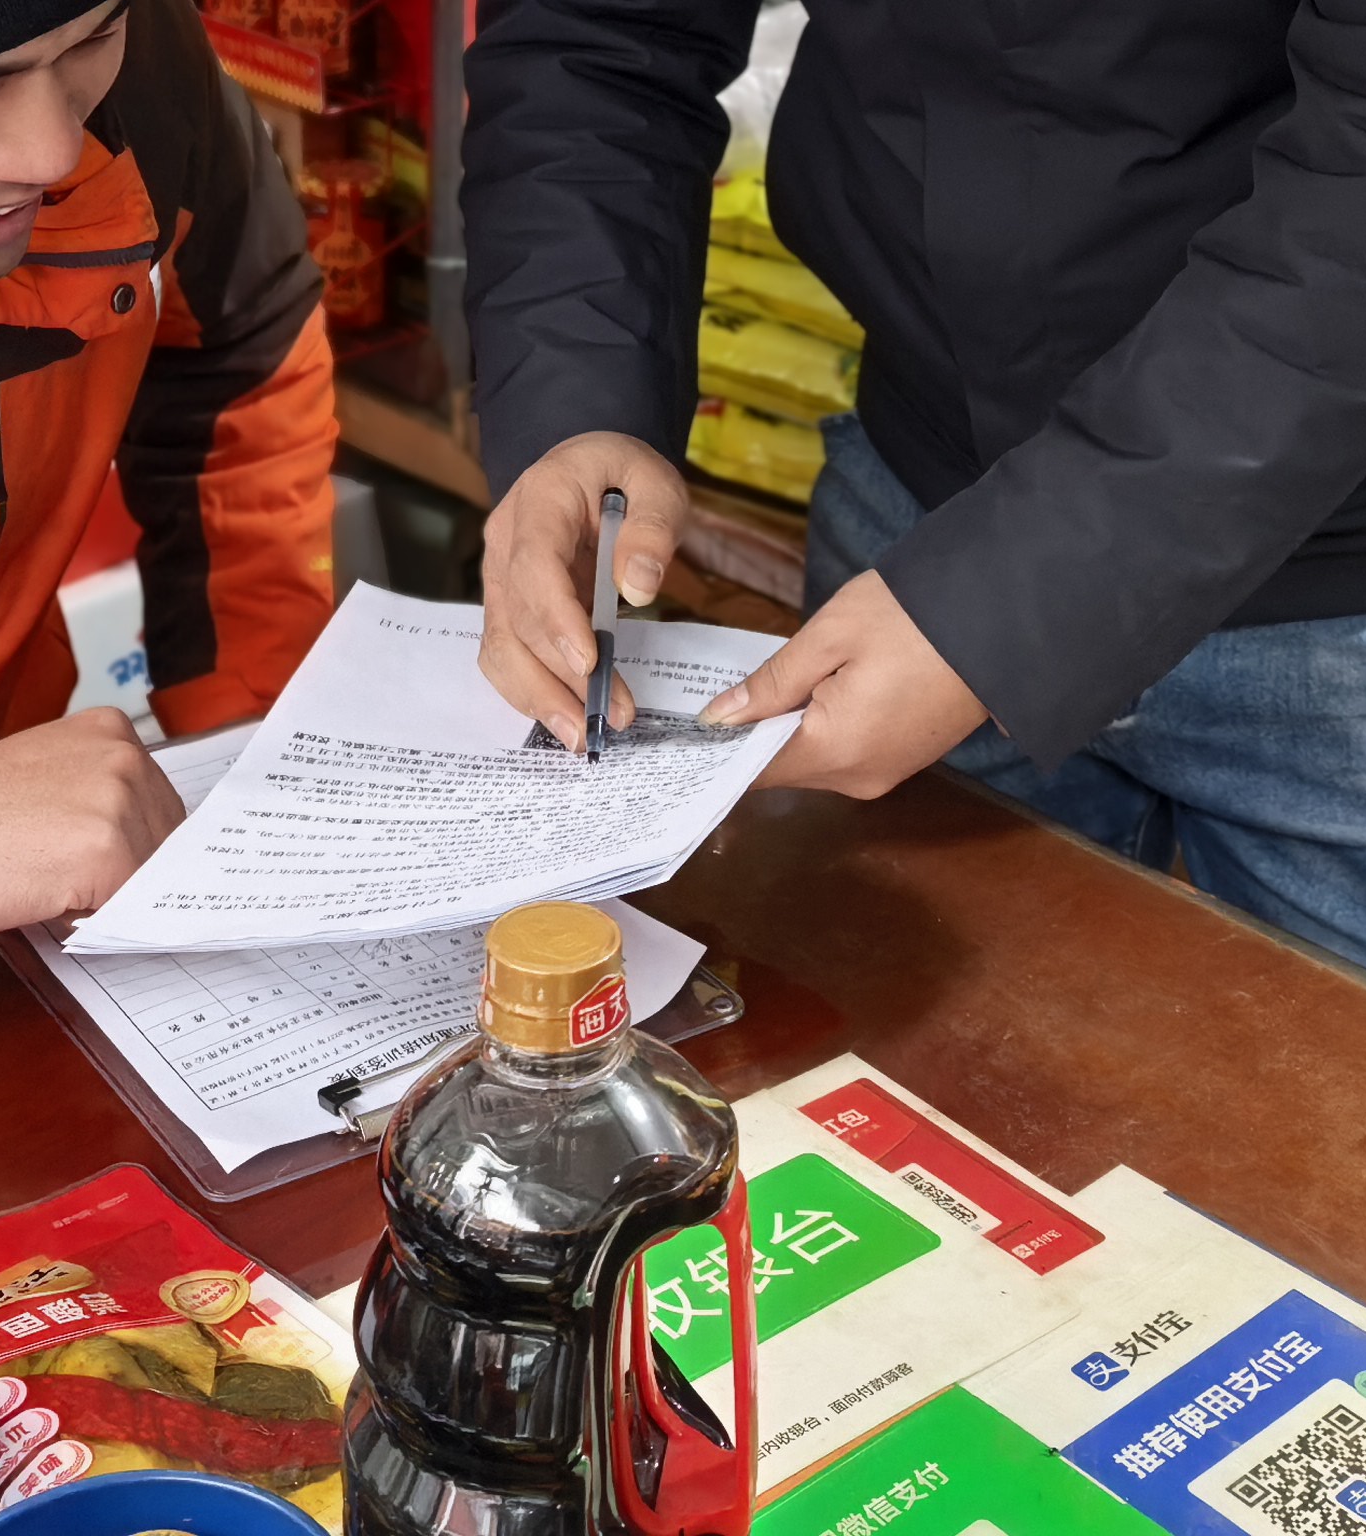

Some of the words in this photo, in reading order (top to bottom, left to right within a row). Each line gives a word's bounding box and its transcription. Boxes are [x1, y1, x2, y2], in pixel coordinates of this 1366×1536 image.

[1108, 1309, 1194, 1368] 支付宝
[1111, 1329, 1323, 1481] 推荐使用支付宝
